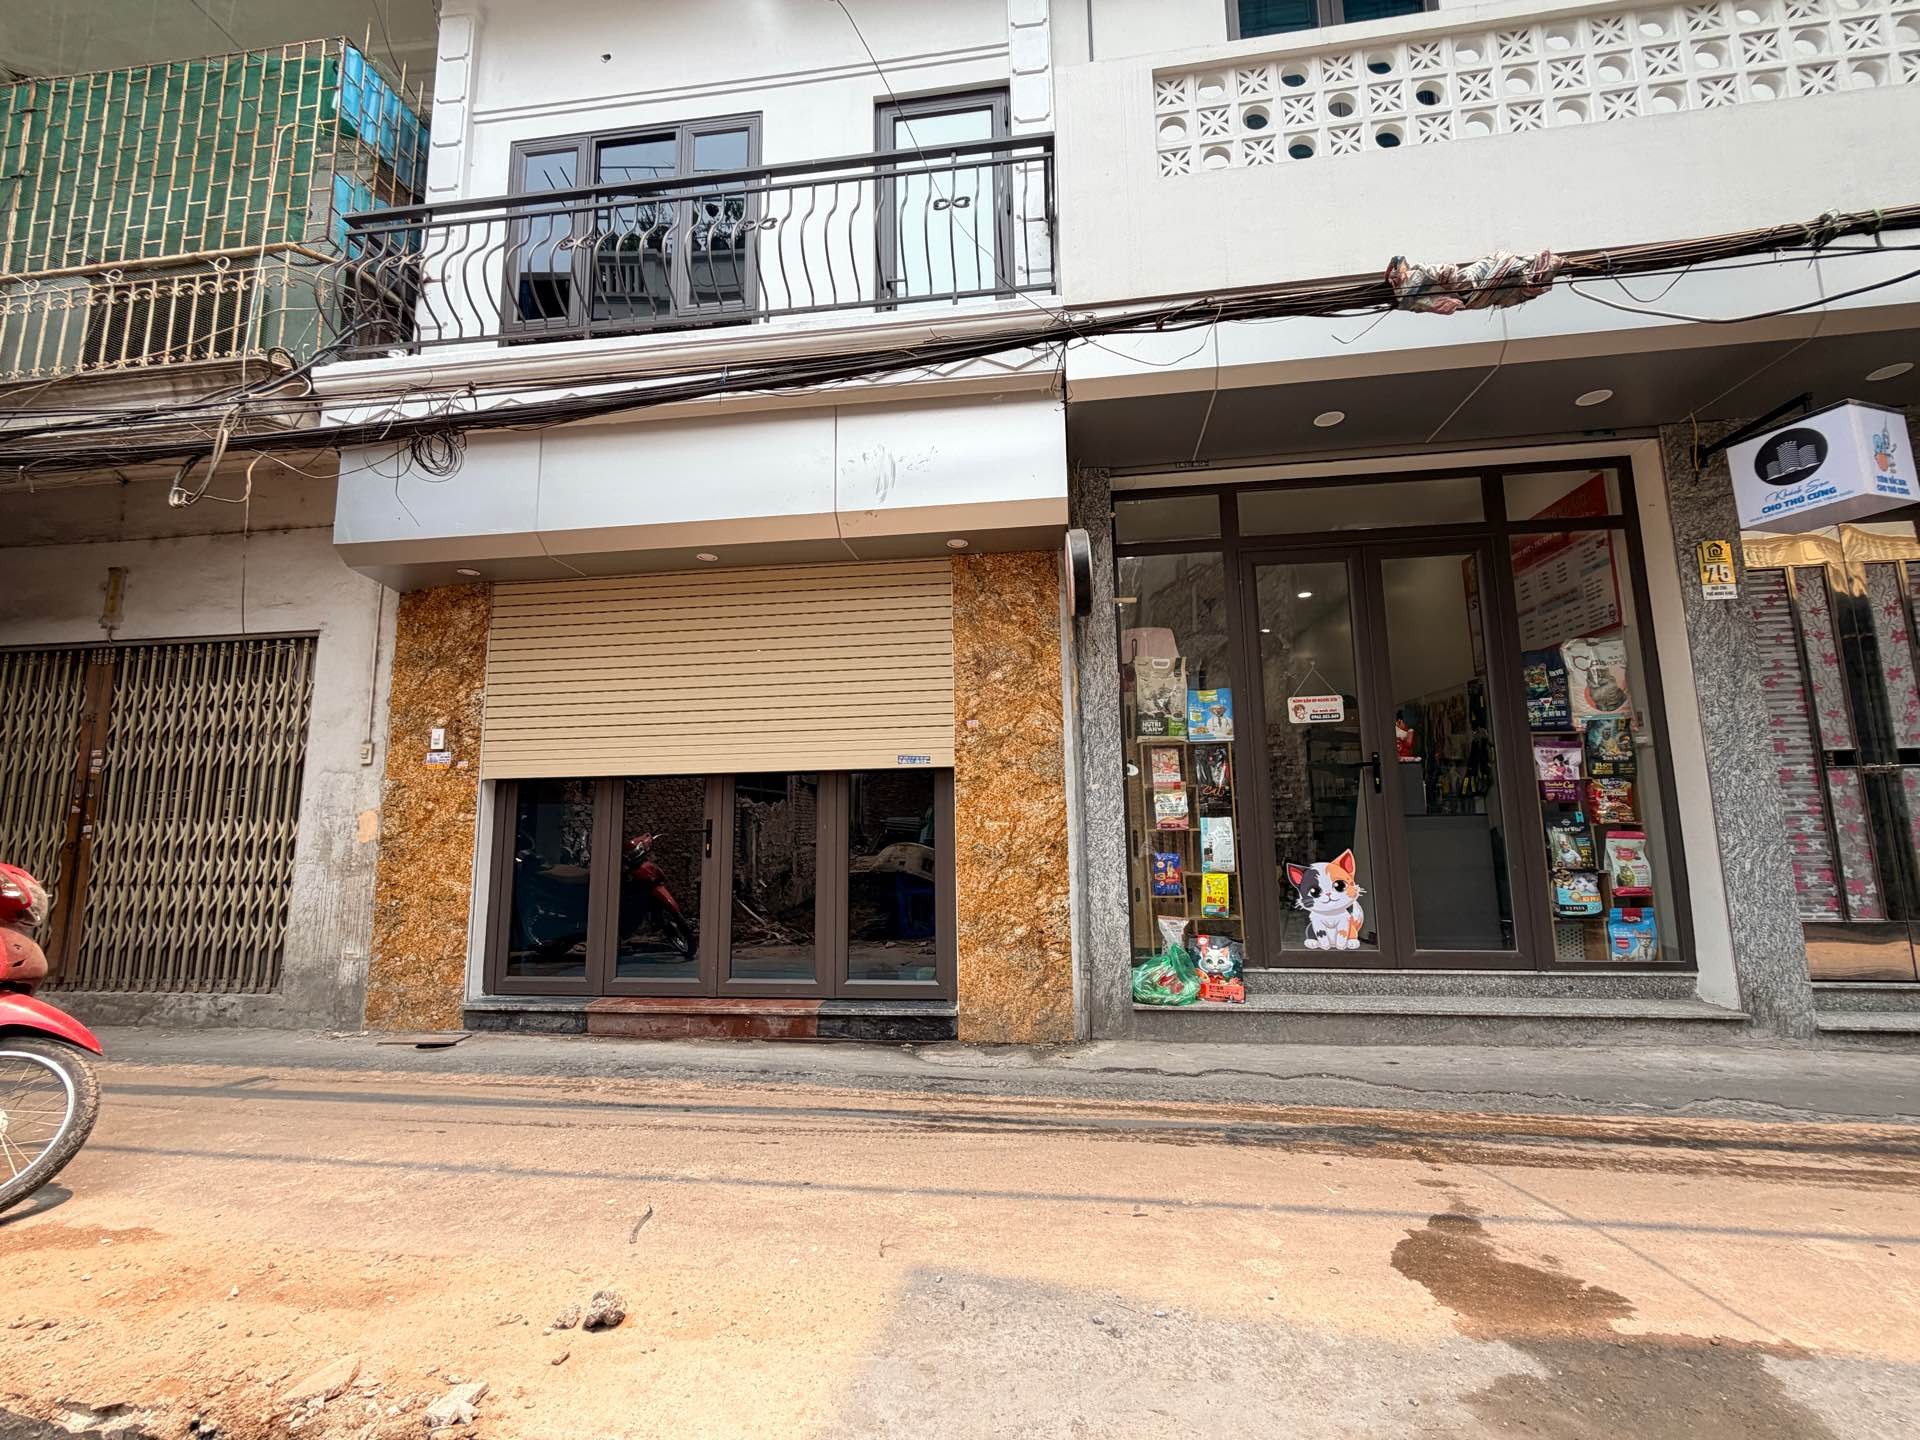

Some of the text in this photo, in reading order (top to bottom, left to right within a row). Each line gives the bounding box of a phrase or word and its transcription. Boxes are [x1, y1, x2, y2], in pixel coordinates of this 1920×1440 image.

[1762, 503, 1782, 514] CHO
[1784, 495, 1805, 507] THÚ
[1807, 486, 1837, 500] CƯNG
[1704, 564, 1731, 583] 75
